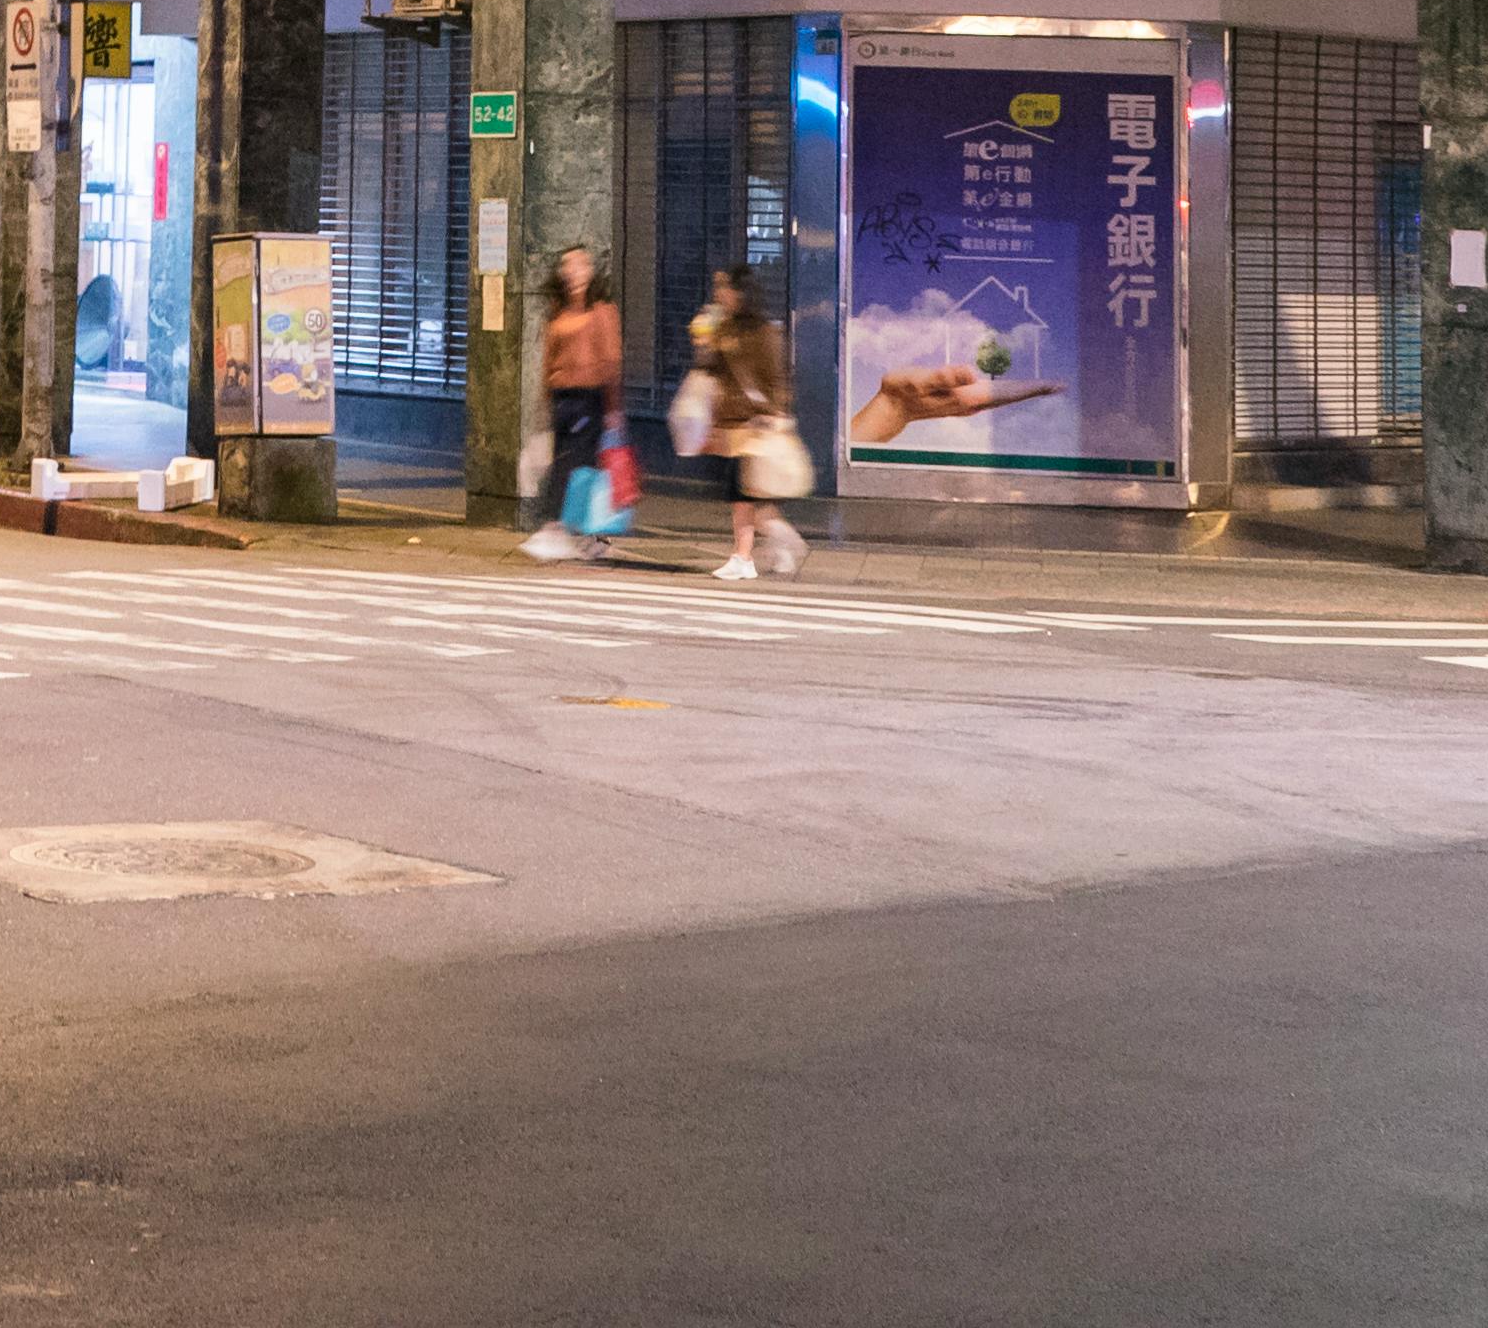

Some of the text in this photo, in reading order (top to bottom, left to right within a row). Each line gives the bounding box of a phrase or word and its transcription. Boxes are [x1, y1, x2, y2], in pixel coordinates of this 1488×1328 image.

[86, 13, 122, 71] 響
[474, 104, 514, 123] 52-42
[1106, 92, 1157, 329] 電子銀行
[306, 312, 324, 332] 50
